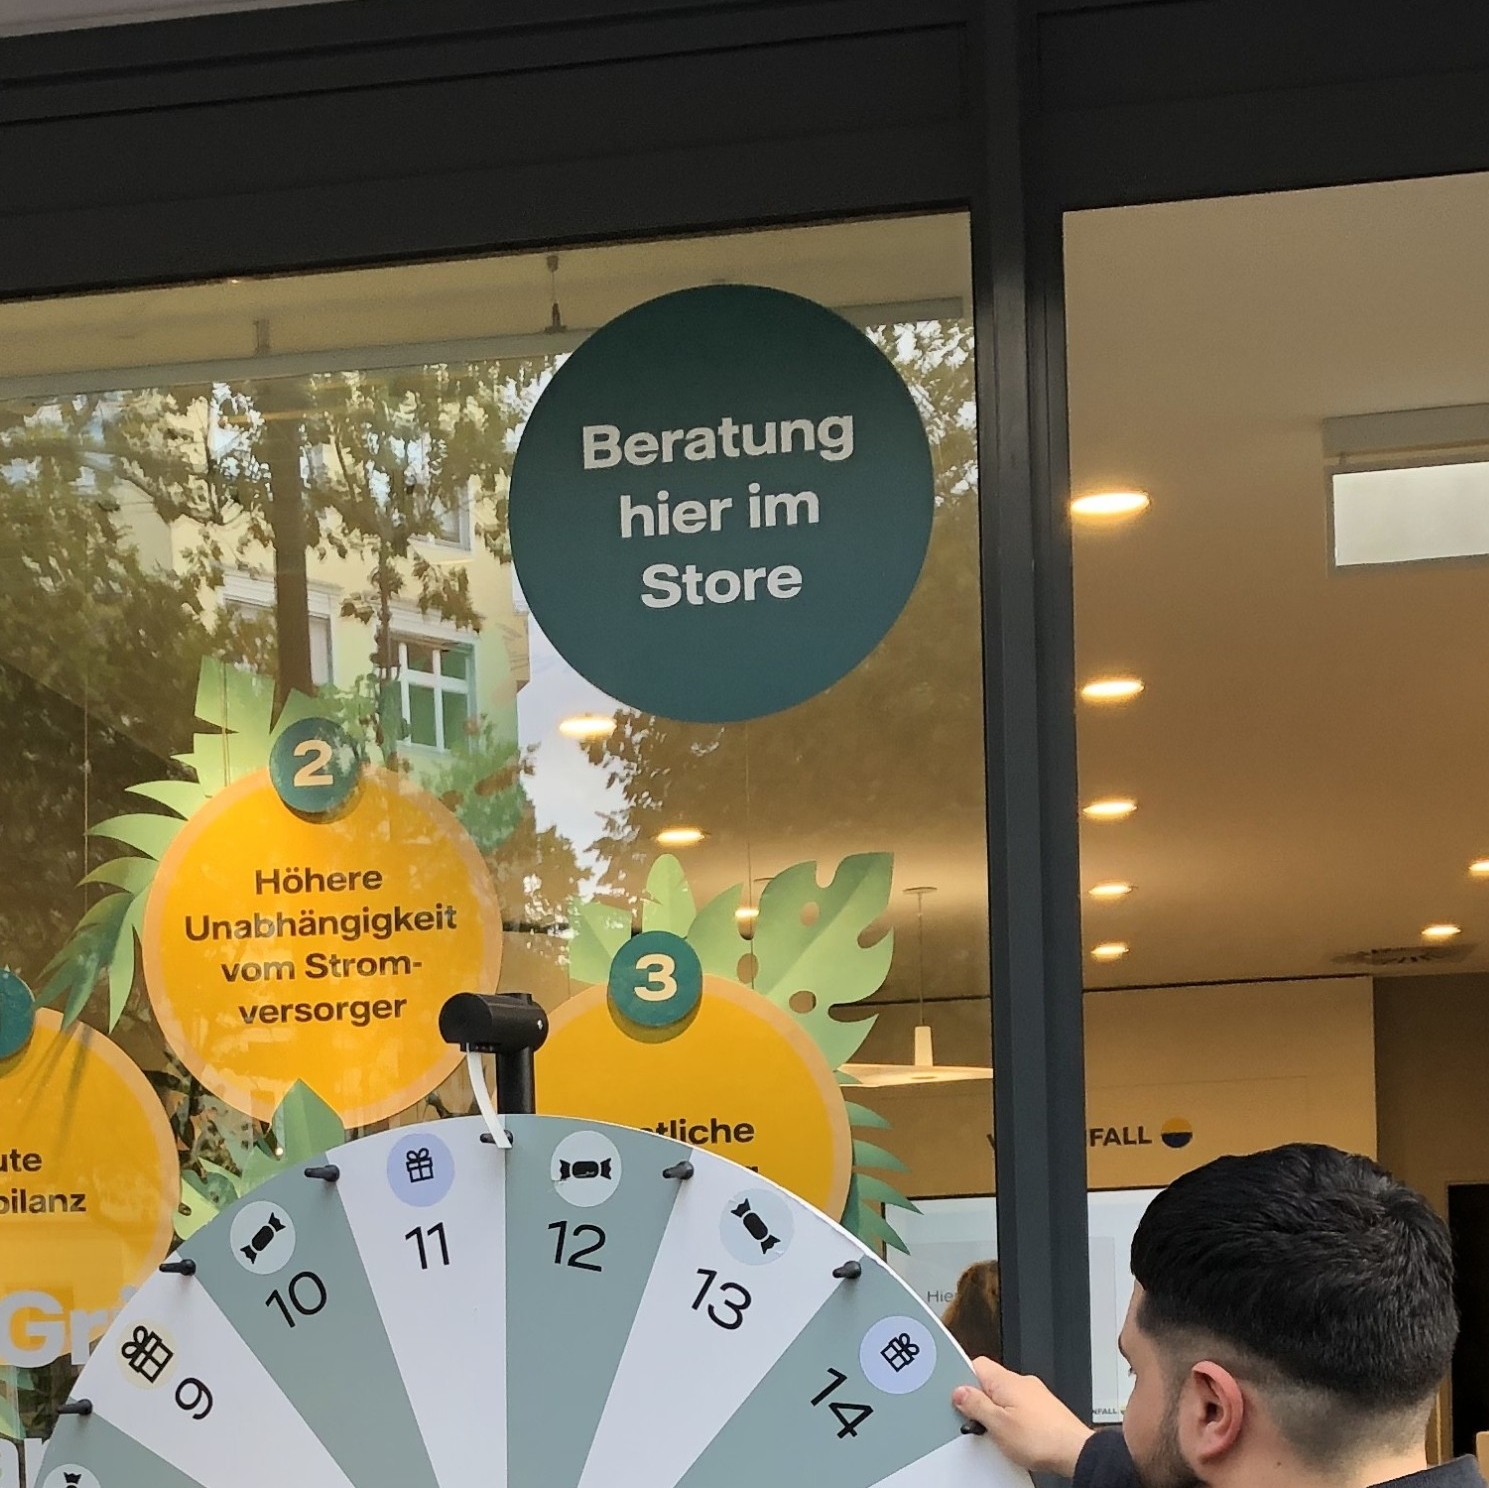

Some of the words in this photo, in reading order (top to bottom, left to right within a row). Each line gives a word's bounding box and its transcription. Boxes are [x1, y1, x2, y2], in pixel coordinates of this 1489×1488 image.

[582, 415, 854, 469] Beratung
[620, 490, 732, 538] hier
[748, 483, 820, 529] im
[641, 563, 803, 609] Store
[293, 740, 334, 787] 2
[255, 867, 383, 895] Höhere
[185, 903, 457, 941] Unabhängigkeit
[221, 959, 295, 983] vom
[305, 952, 423, 979] Strom-
[633, 953, 677, 1002] 3
[238, 996, 407, 1028] versorger
[405, 1222, 450, 1270] 11
[548, 1220, 606, 1272] 12
[265, 1271, 327, 1328] 10
[690, 1268, 752, 1330] 13
[927, 1290, 956, 1303] Hie
[174, 1377, 213, 1420] 9
[810, 1368, 874, 1439] 14
